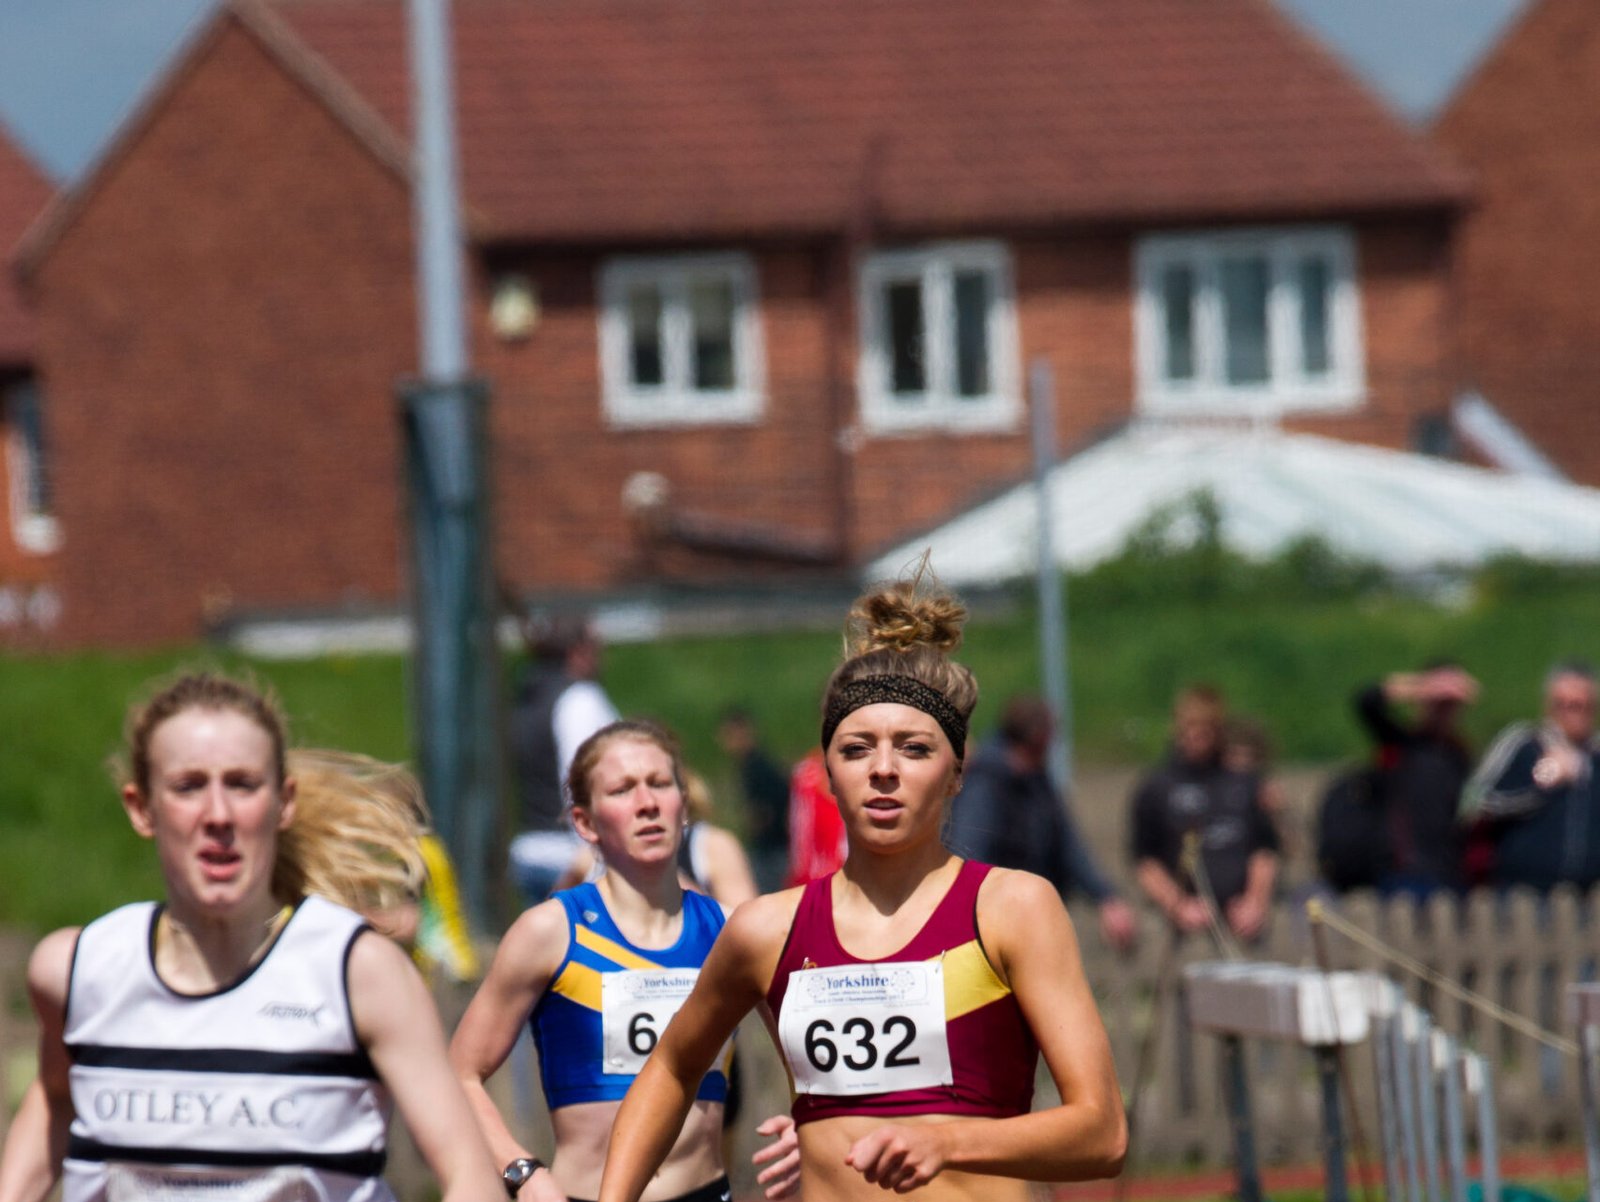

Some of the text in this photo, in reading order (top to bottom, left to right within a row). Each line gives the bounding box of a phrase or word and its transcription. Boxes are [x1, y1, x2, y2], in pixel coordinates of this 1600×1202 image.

[827, 974, 889, 989] Yorkshire
[804, 1015, 921, 1073] 632
[94, 1088, 305, 1130] OTLEY A.C.
